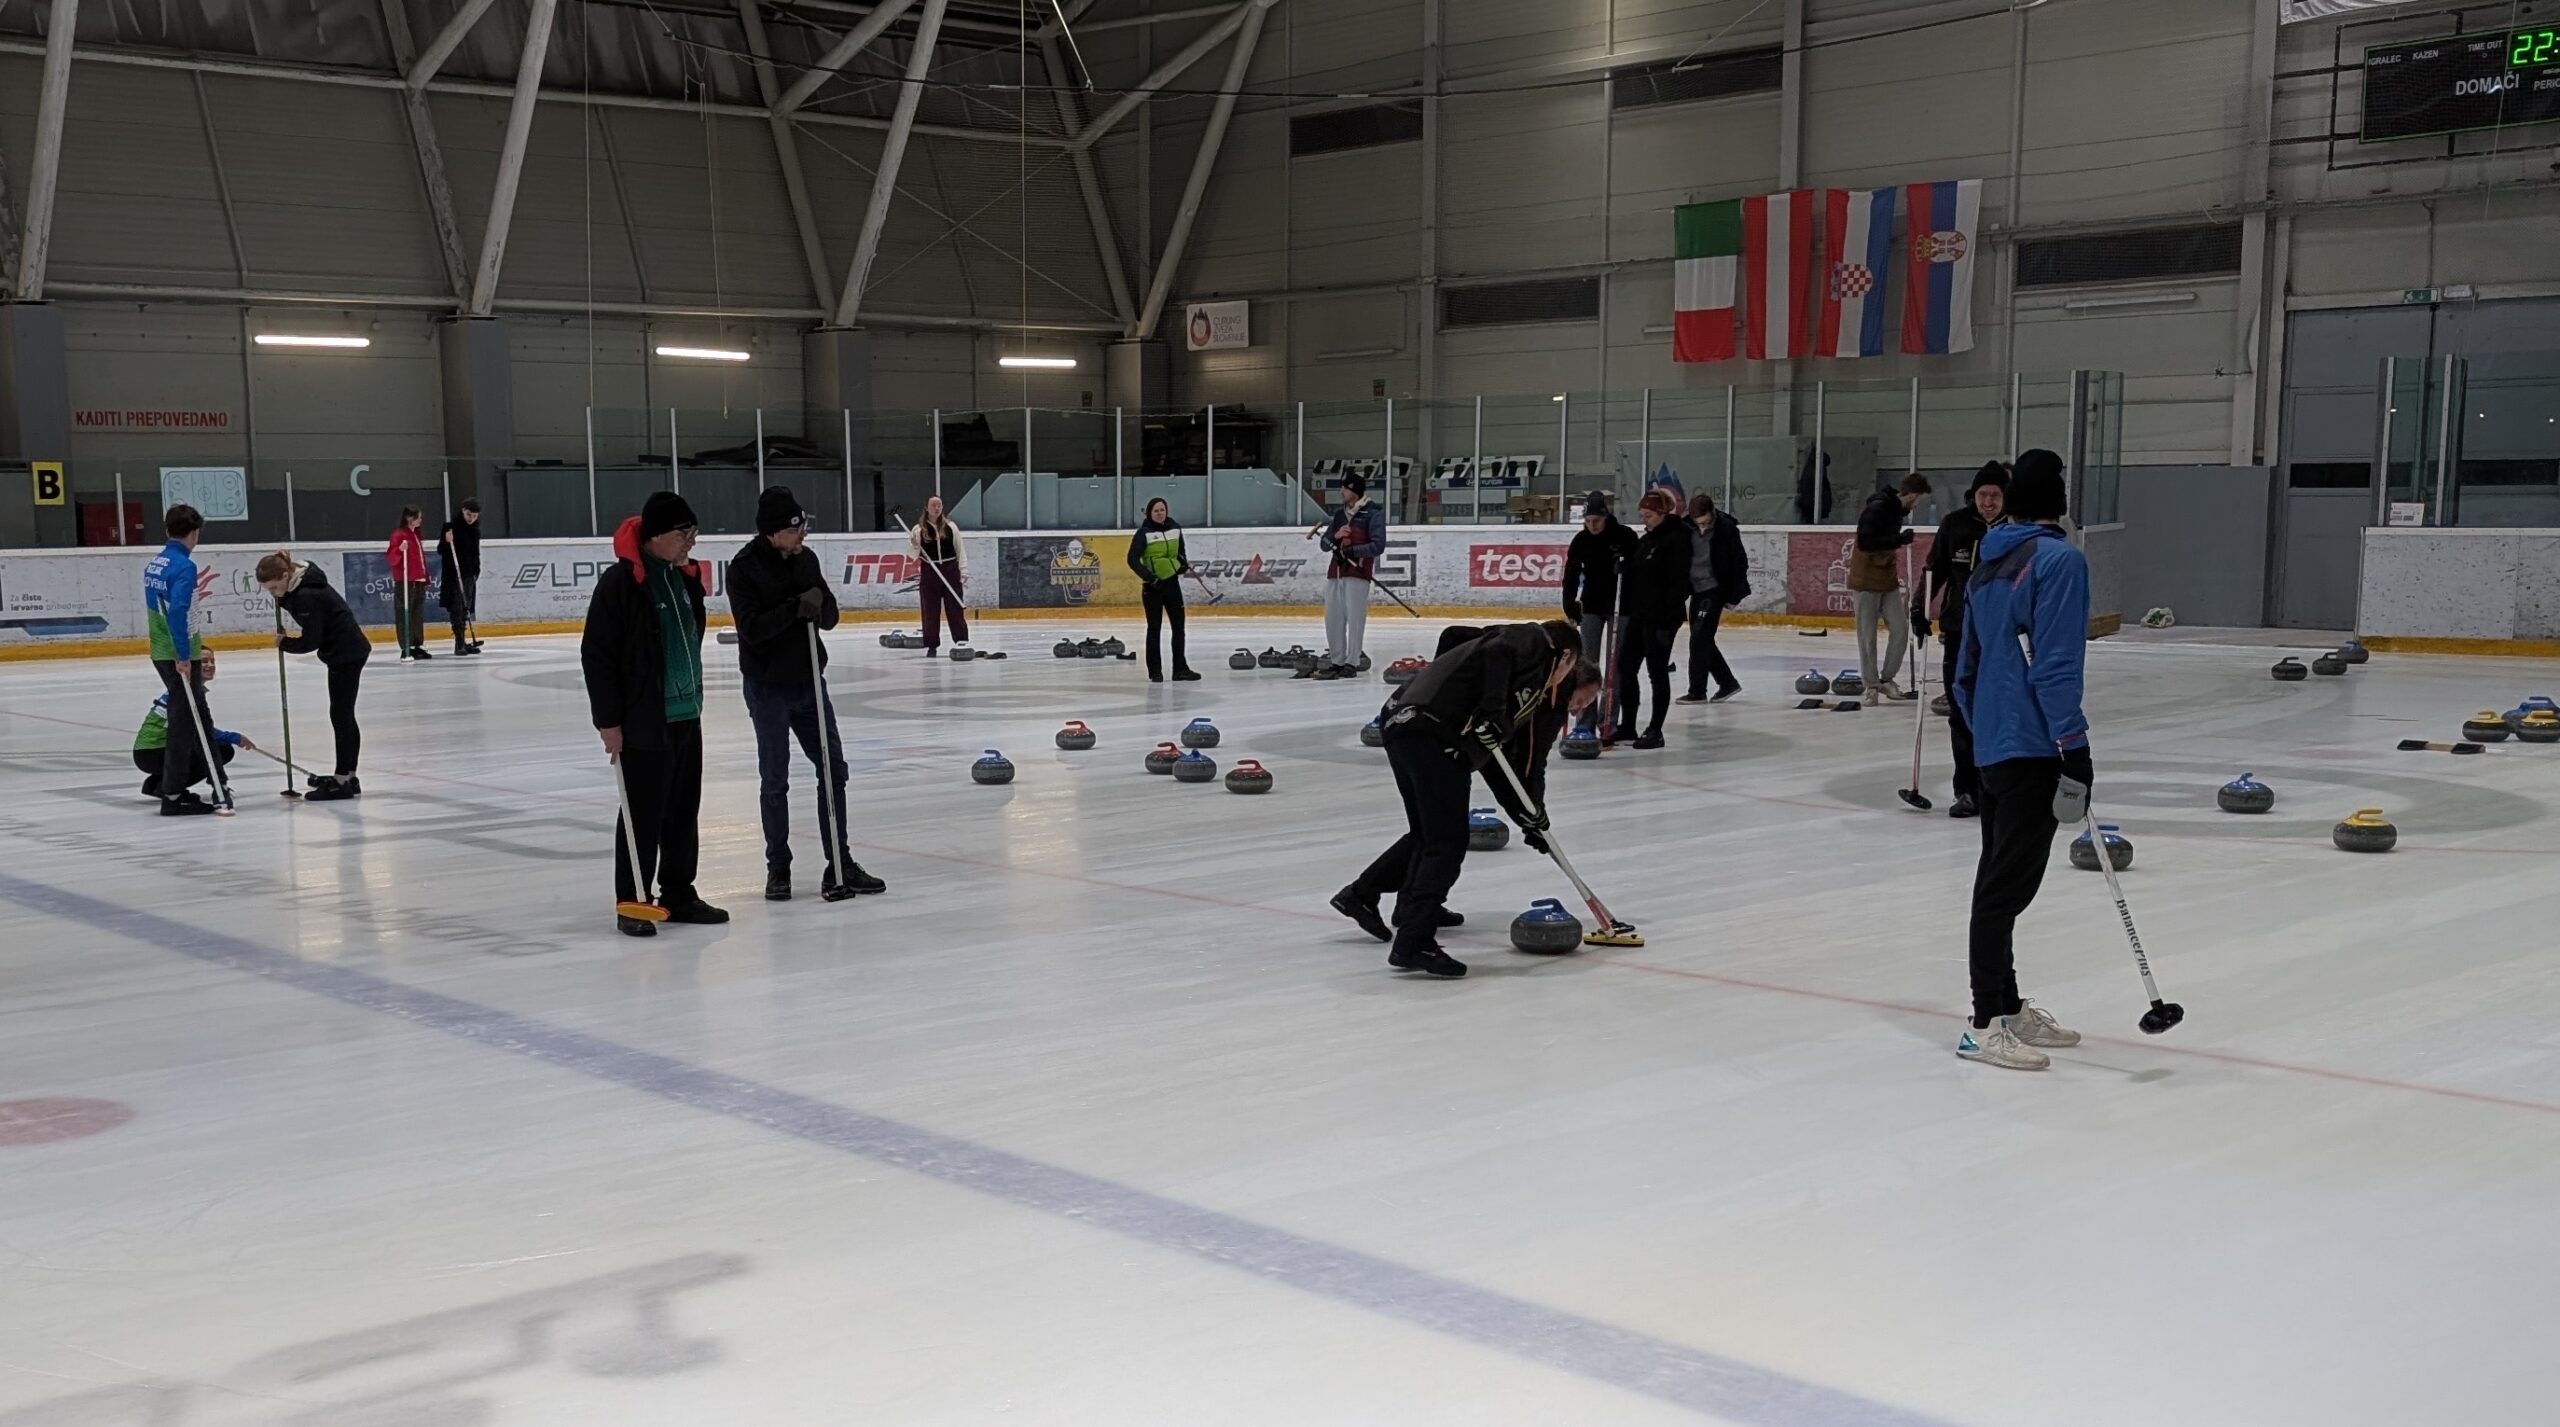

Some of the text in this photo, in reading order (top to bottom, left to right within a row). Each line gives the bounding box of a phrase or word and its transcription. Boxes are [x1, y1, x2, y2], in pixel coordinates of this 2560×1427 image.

[2468, 43, 2485, 52] TIME
[2487, 40, 2503, 50] OUT
[2369, 54, 2402, 66] IGRALEC
[2455, 71, 2520, 96] DOMAČI
[76, 411, 228, 427] KADITI PREPOVEDANO
[37, 469, 61, 500] B
[350, 464, 372, 496] C
[1476, 548, 1563, 582] tesa
